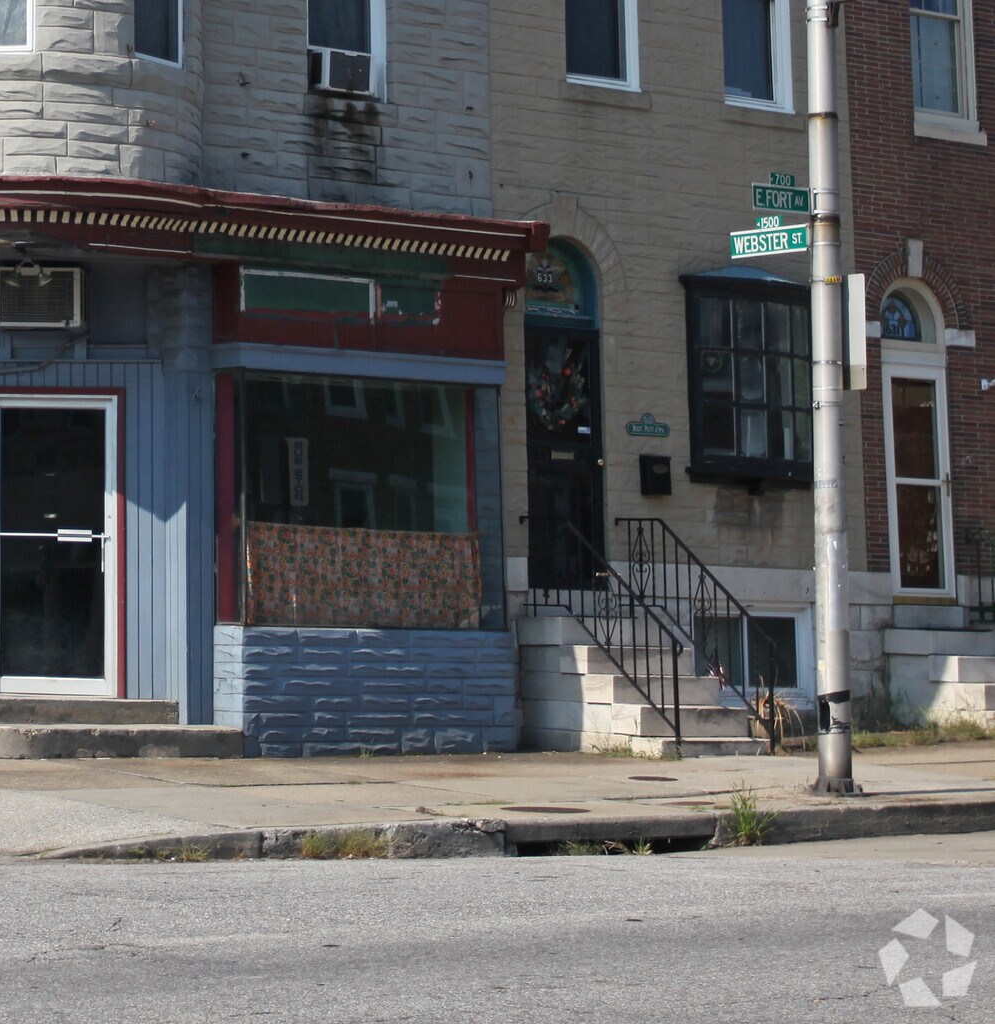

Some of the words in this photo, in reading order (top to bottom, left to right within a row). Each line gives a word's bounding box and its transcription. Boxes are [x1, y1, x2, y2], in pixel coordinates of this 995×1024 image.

[775, 173, 791, 186] 700
[761, 216, 779, 229] 1500
[733, 232, 788, 254] WEBSTER
[537, 273, 553, 283] 633
